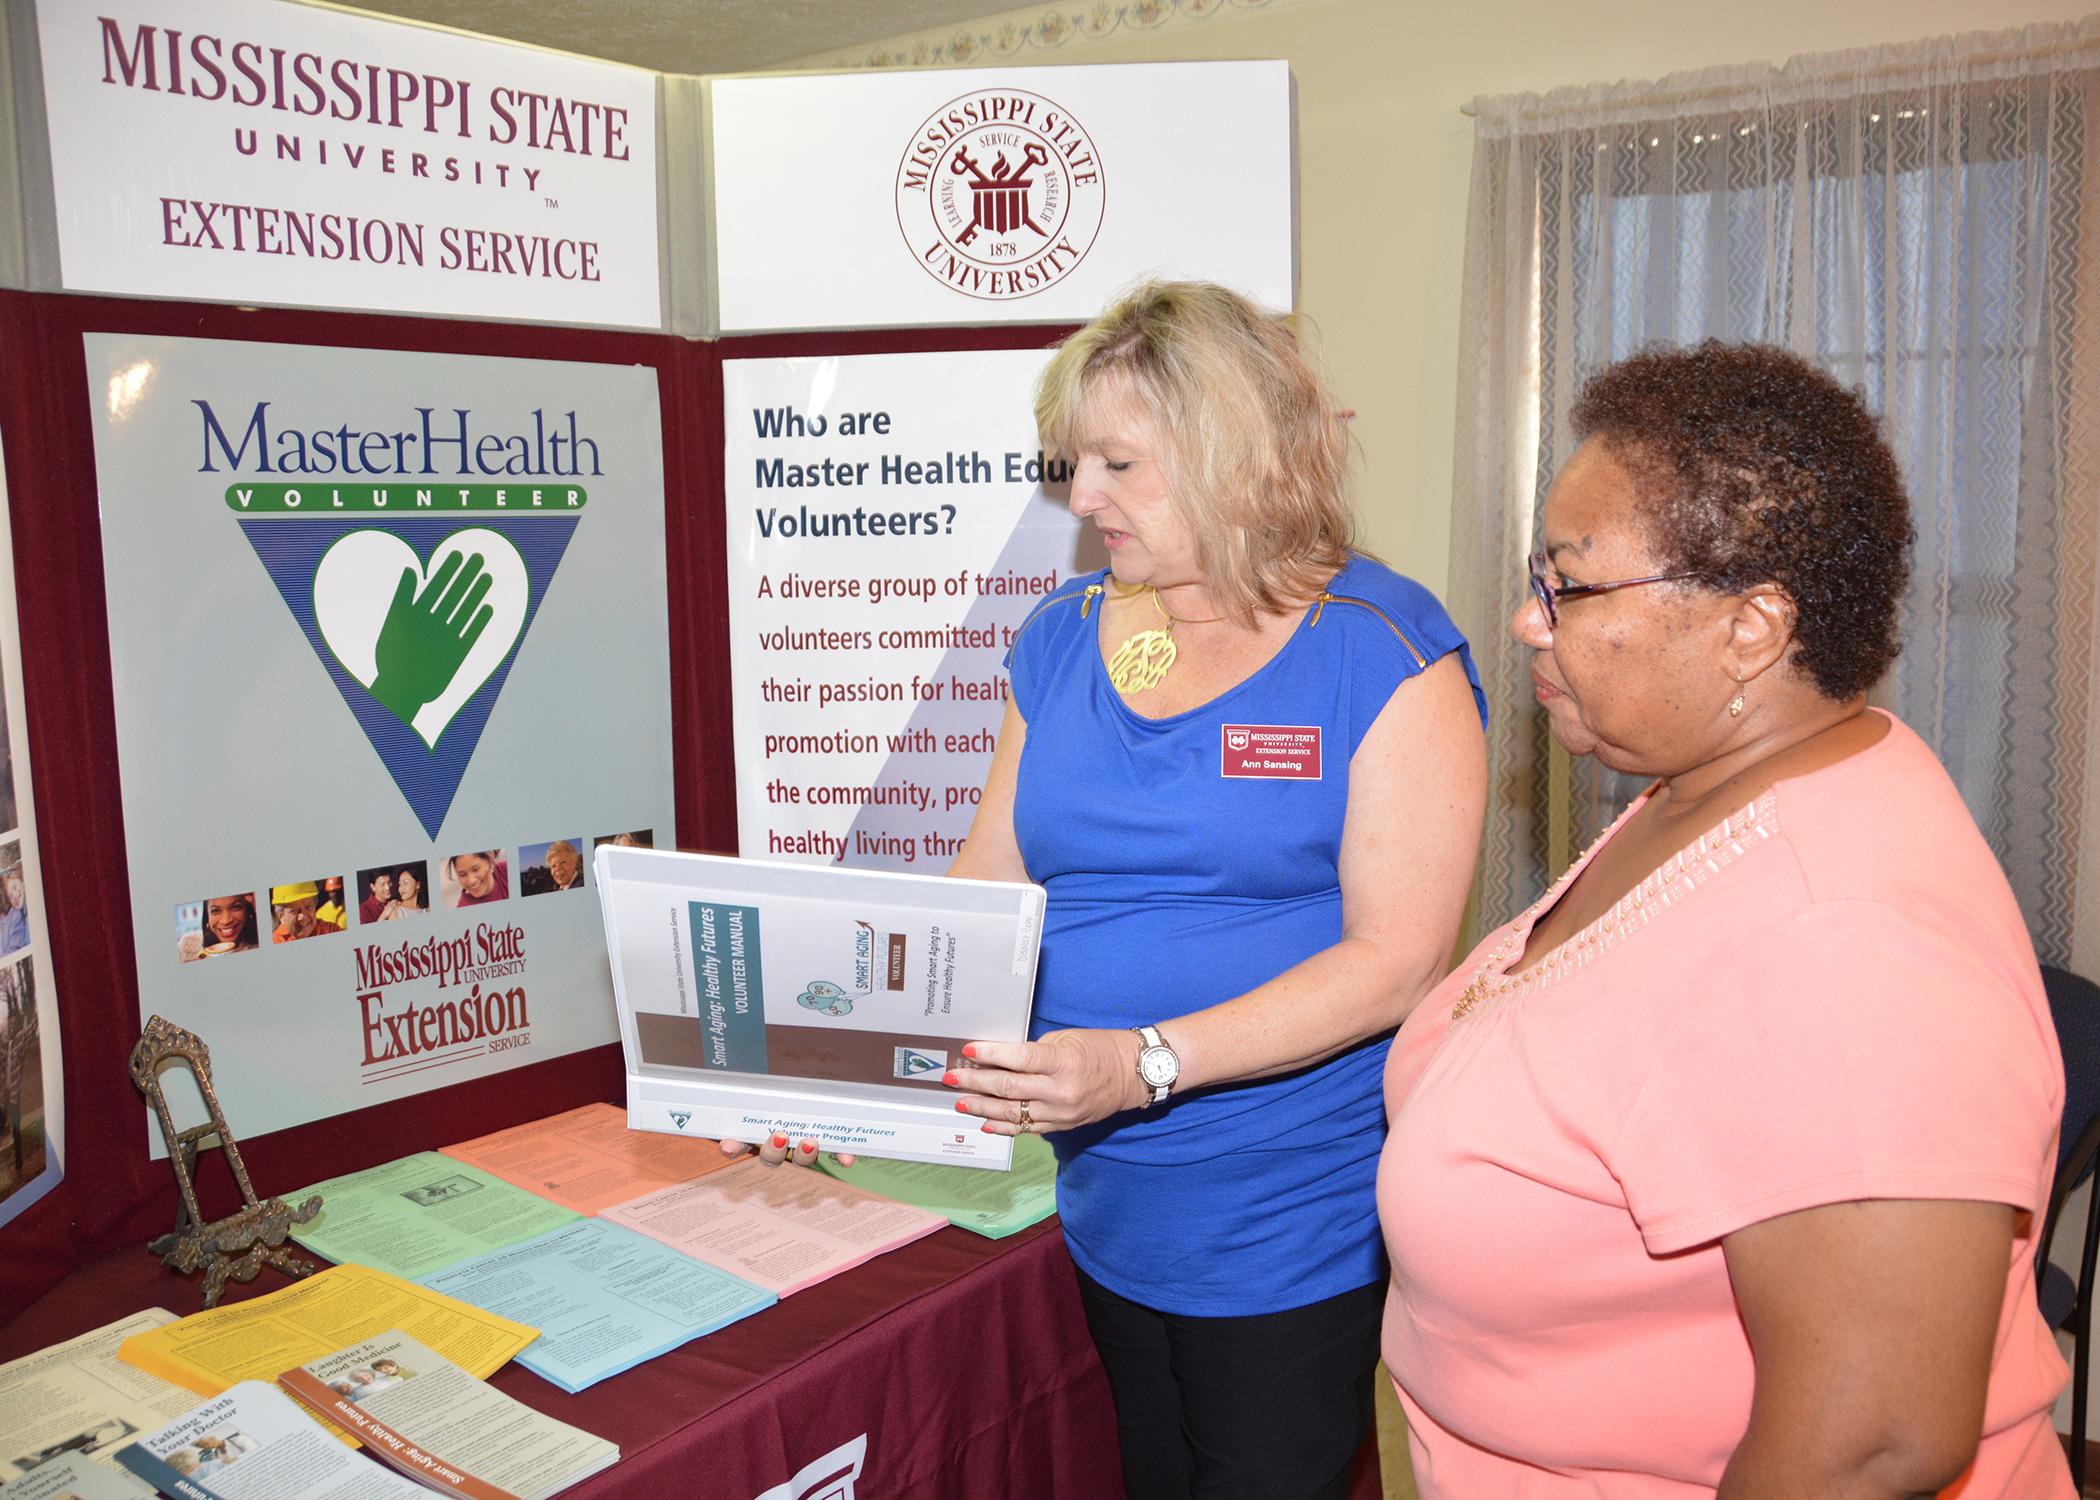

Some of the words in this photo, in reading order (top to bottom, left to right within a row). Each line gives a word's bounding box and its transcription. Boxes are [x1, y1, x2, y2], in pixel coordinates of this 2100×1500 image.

[97, 16, 471, 138] MISSISSIPPI
[489, 86, 630, 161] STATE
[904, 97, 1037, 192] MISSISSIPPI
[1039, 112, 1098, 188] STATE
[979, 132, 1021, 148] SERVICE
[235, 128, 541, 191] UNIVERSITY
[941, 178, 963, 228] LEARNING
[1039, 170, 1059, 223] RESEARCH
[160, 197, 424, 266] EXTENSION
[440, 227, 601, 282] SERVICE
[989, 243, 1017, 256] 1878
[924, 236, 1080, 295] UNIVERSITY
[190, 399, 605, 476] MasterHealth
[753, 406, 828, 438] Who
[838, 409, 891, 435] are
[755, 457, 869, 489] Master
[880, 451, 992, 486] Health
[236, 489, 579, 507] VOLUNTEER
[756, 503, 957, 538] Volunteers?
[757, 573, 774, 599] A
[780, 573, 861, 599] diverse
[868, 575, 937, 604] group
[944, 570, 969, 596] of
[975, 570, 1057, 595] trained
[759, 626, 873, 650] volunteers
[878, 623, 996, 649] committed
[1001, 625, 1018, 648] t
[762, 677, 811, 702] their
[819, 678, 903, 708] passion
[911, 675, 944, 701] for
[765, 730, 878, 758] promotion
[886, 728, 937, 753] with
[944, 728, 995, 753] each
[1251, 733, 1293, 742] MISSISSIPPI
[1242, 760, 1261, 768] Ann
[1263, 760, 1302, 771] Sansing
[766, 779, 801, 804] the
[806, 781, 937, 809] community,
[768, 830, 848, 861] healthy
[856, 830, 915, 862] living
[673, 927, 681, 952] Extension
[701, 907, 716, 953] Futures
[729, 910, 745, 957] MANUAL
[856, 930, 869, 957] AGING
[931, 926, 940, 935] to
[353, 929, 474, 991] Mississippi
[476, 922, 526, 966] State
[891, 944, 901, 982] VOLUNTEER
[929, 937, 941, 960] Aging
[464, 959, 526, 984] UNIVERSITY
[676, 953, 684, 978] University
[701, 957, 721, 999] Healthy
[856, 959, 869, 990] SMART
[928, 961, 938, 980] Smart
[943, 965, 955, 992] Healthy
[732, 959, 748, 1014] VOLUNTEER
[708, 1001, 727, 1035] Aging:
[941, 993, 950, 1014] Ensure
[356, 983, 530, 1067] Extension
[488, 1032, 531, 1054] SERVICE
[712, 1035, 727, 1067] Smart
[742, 1116, 772, 1125] Smart
[774, 1119, 809, 1130] Aging:
[812, 1123, 854, 1134] Healthy
[855, 1126, 896, 1136] Futures
[822, 1134, 867, 1143] Program
[308, 1347, 361, 1373] Laughter
[362, 1343, 375, 1353] Is
[317, 1362, 350, 1380] Good
[351, 1340, 403, 1364] Medicine
[148, 1418, 200, 1448] Talking
[200, 1396, 235, 1418] With
[335, 1400, 369, 1427] Futures
[156, 1433, 192, 1455] Your
[194, 1407, 239, 1431] Doctor
[368, 1422, 405, 1450] Healthy
[404, 1446, 438, 1468] Aging:
[433, 1465, 465, 1484] Smart
